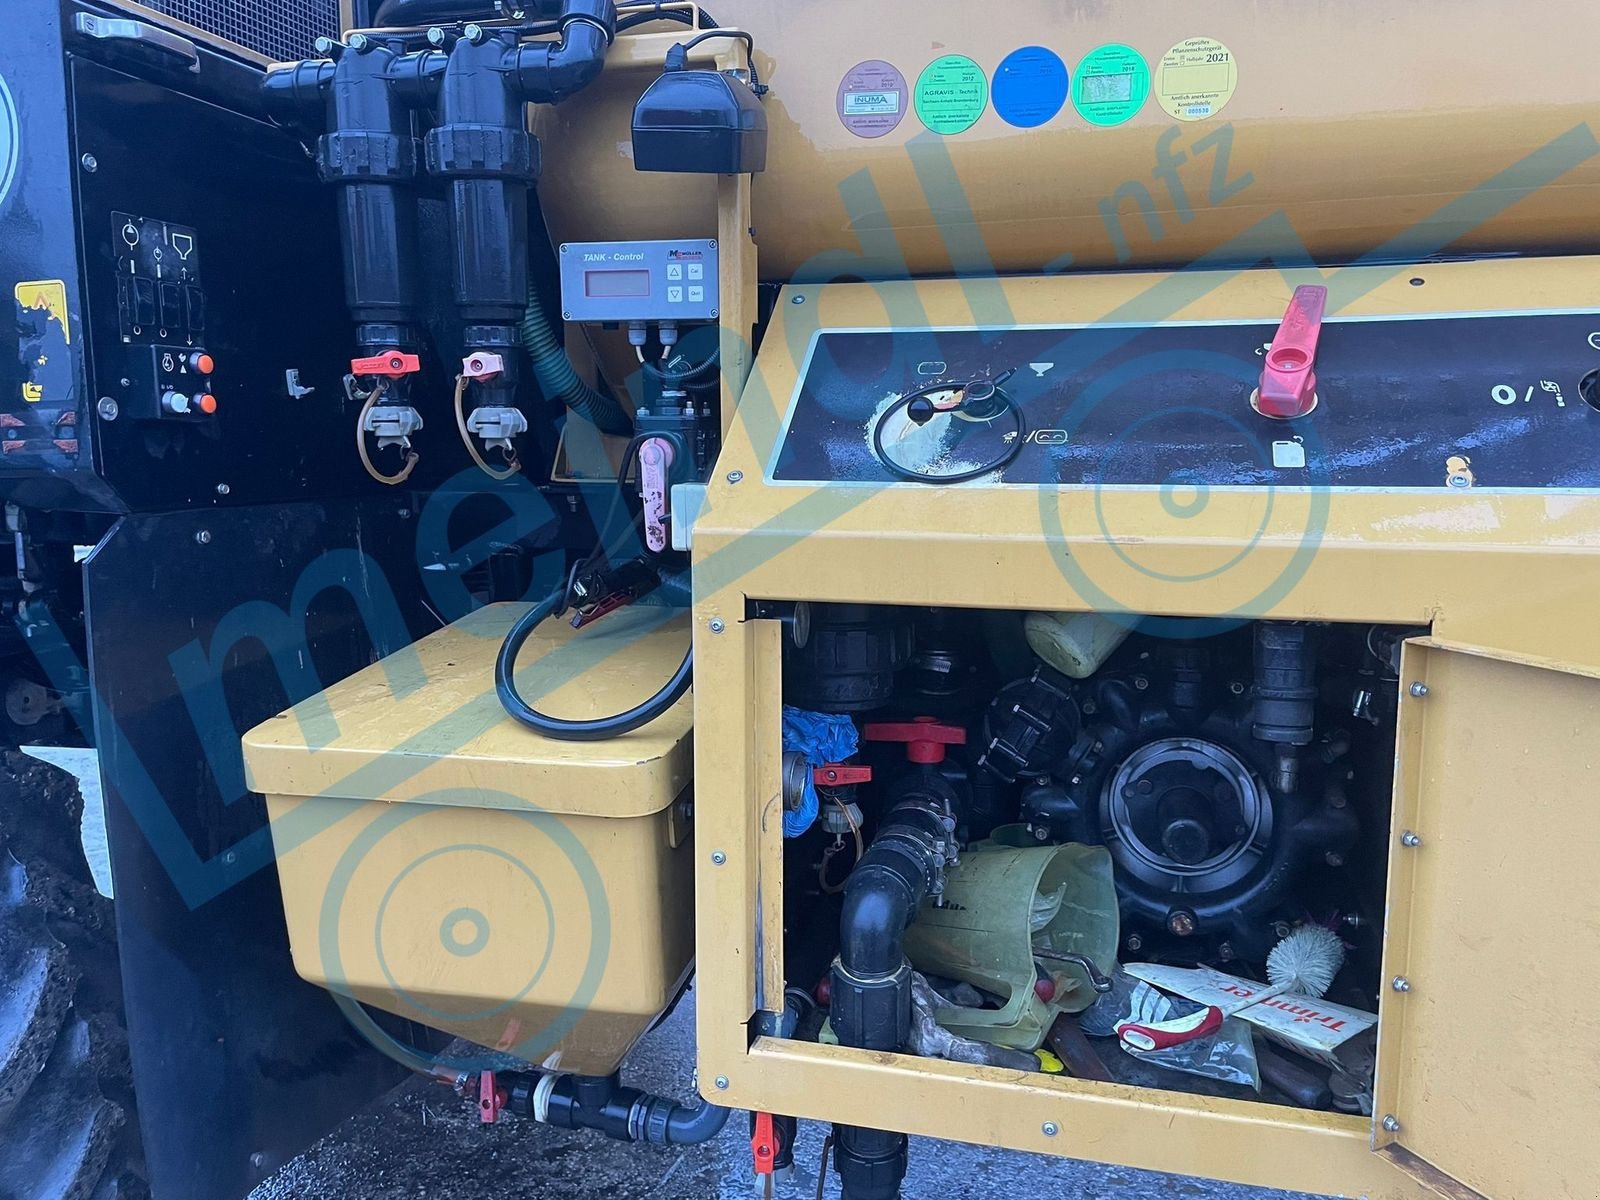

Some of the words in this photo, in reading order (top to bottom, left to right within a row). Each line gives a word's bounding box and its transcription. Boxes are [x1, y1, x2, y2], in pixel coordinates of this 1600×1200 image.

[1206, 53, 1229, 63] 2021
[854, 95, 888, 104] INUMA
[583, 253, 607, 262] TANK
[613, 252, 644, 261] Control
